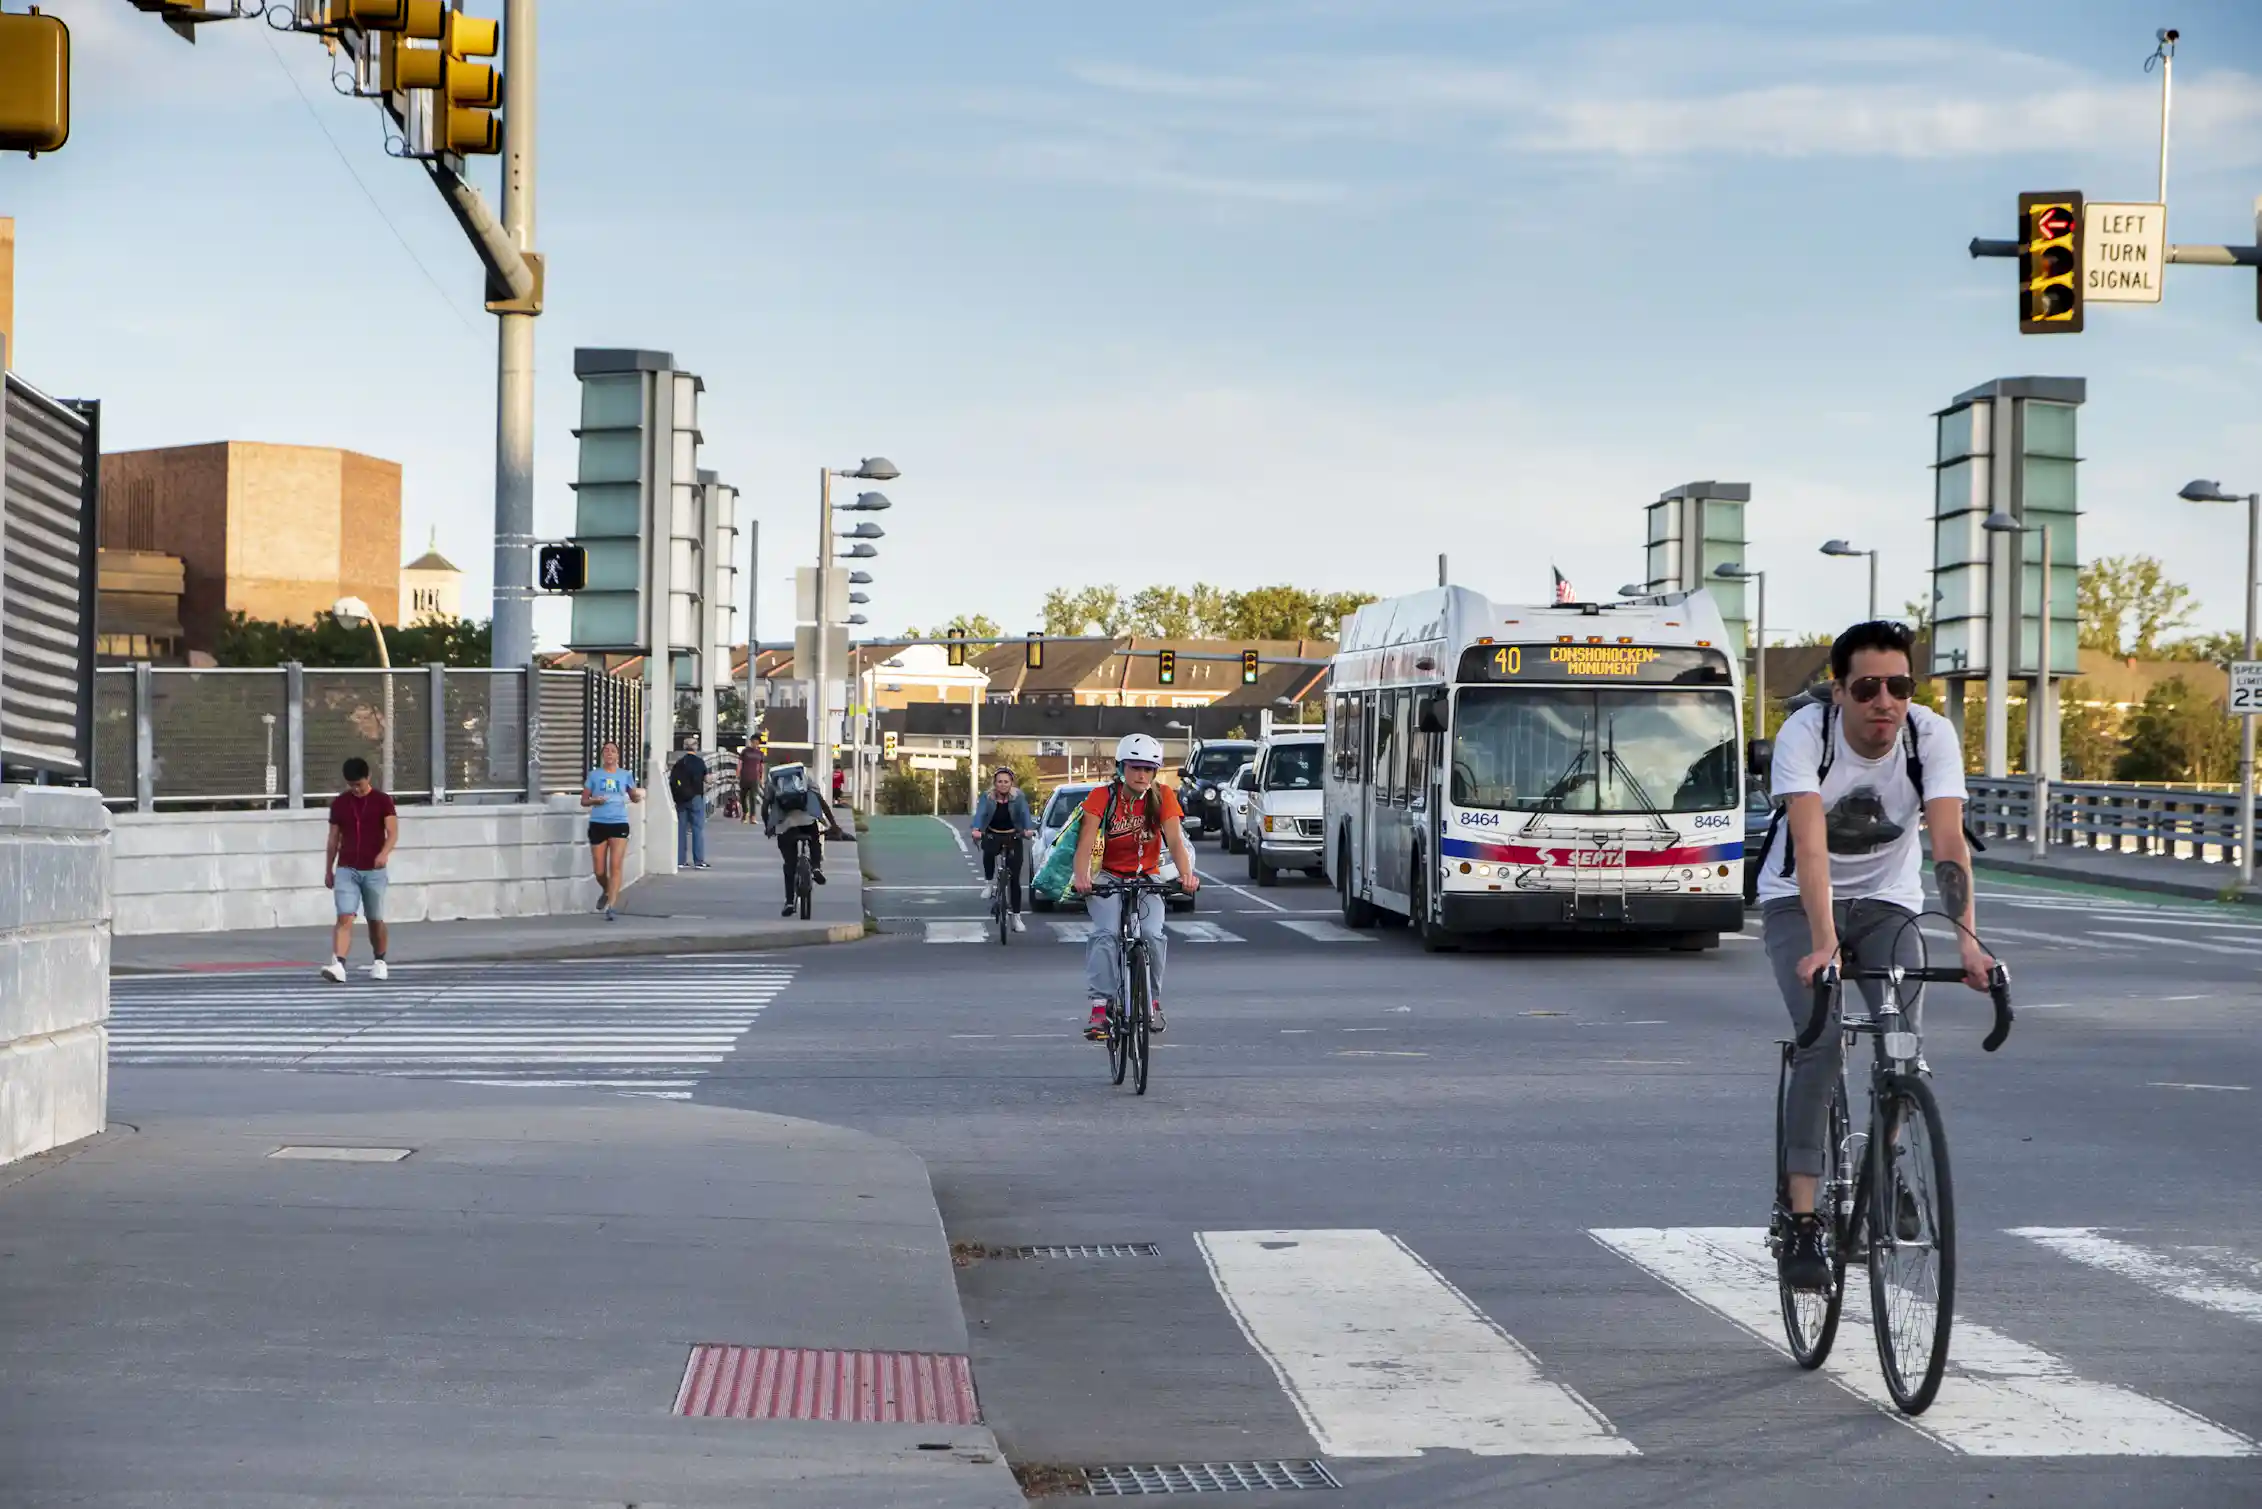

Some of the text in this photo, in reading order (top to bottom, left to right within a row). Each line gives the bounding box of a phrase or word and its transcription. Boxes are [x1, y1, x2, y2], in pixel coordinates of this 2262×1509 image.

[2102, 215, 2146, 234] LEFT
[2100, 244, 2147, 262] TURN
[2089, 270, 2153, 289] SIGNAL
[1495, 647, 1521, 674] 40
[1567, 662, 1640, 675] MONUMENT
[2234, 665, 2262, 675] SPEE
[2234, 688, 2262, 707] 25
[1461, 812, 1499, 826] 8464
[1694, 815, 1730, 828] 8464
[1567, 851, 1625, 866] SEPTA
